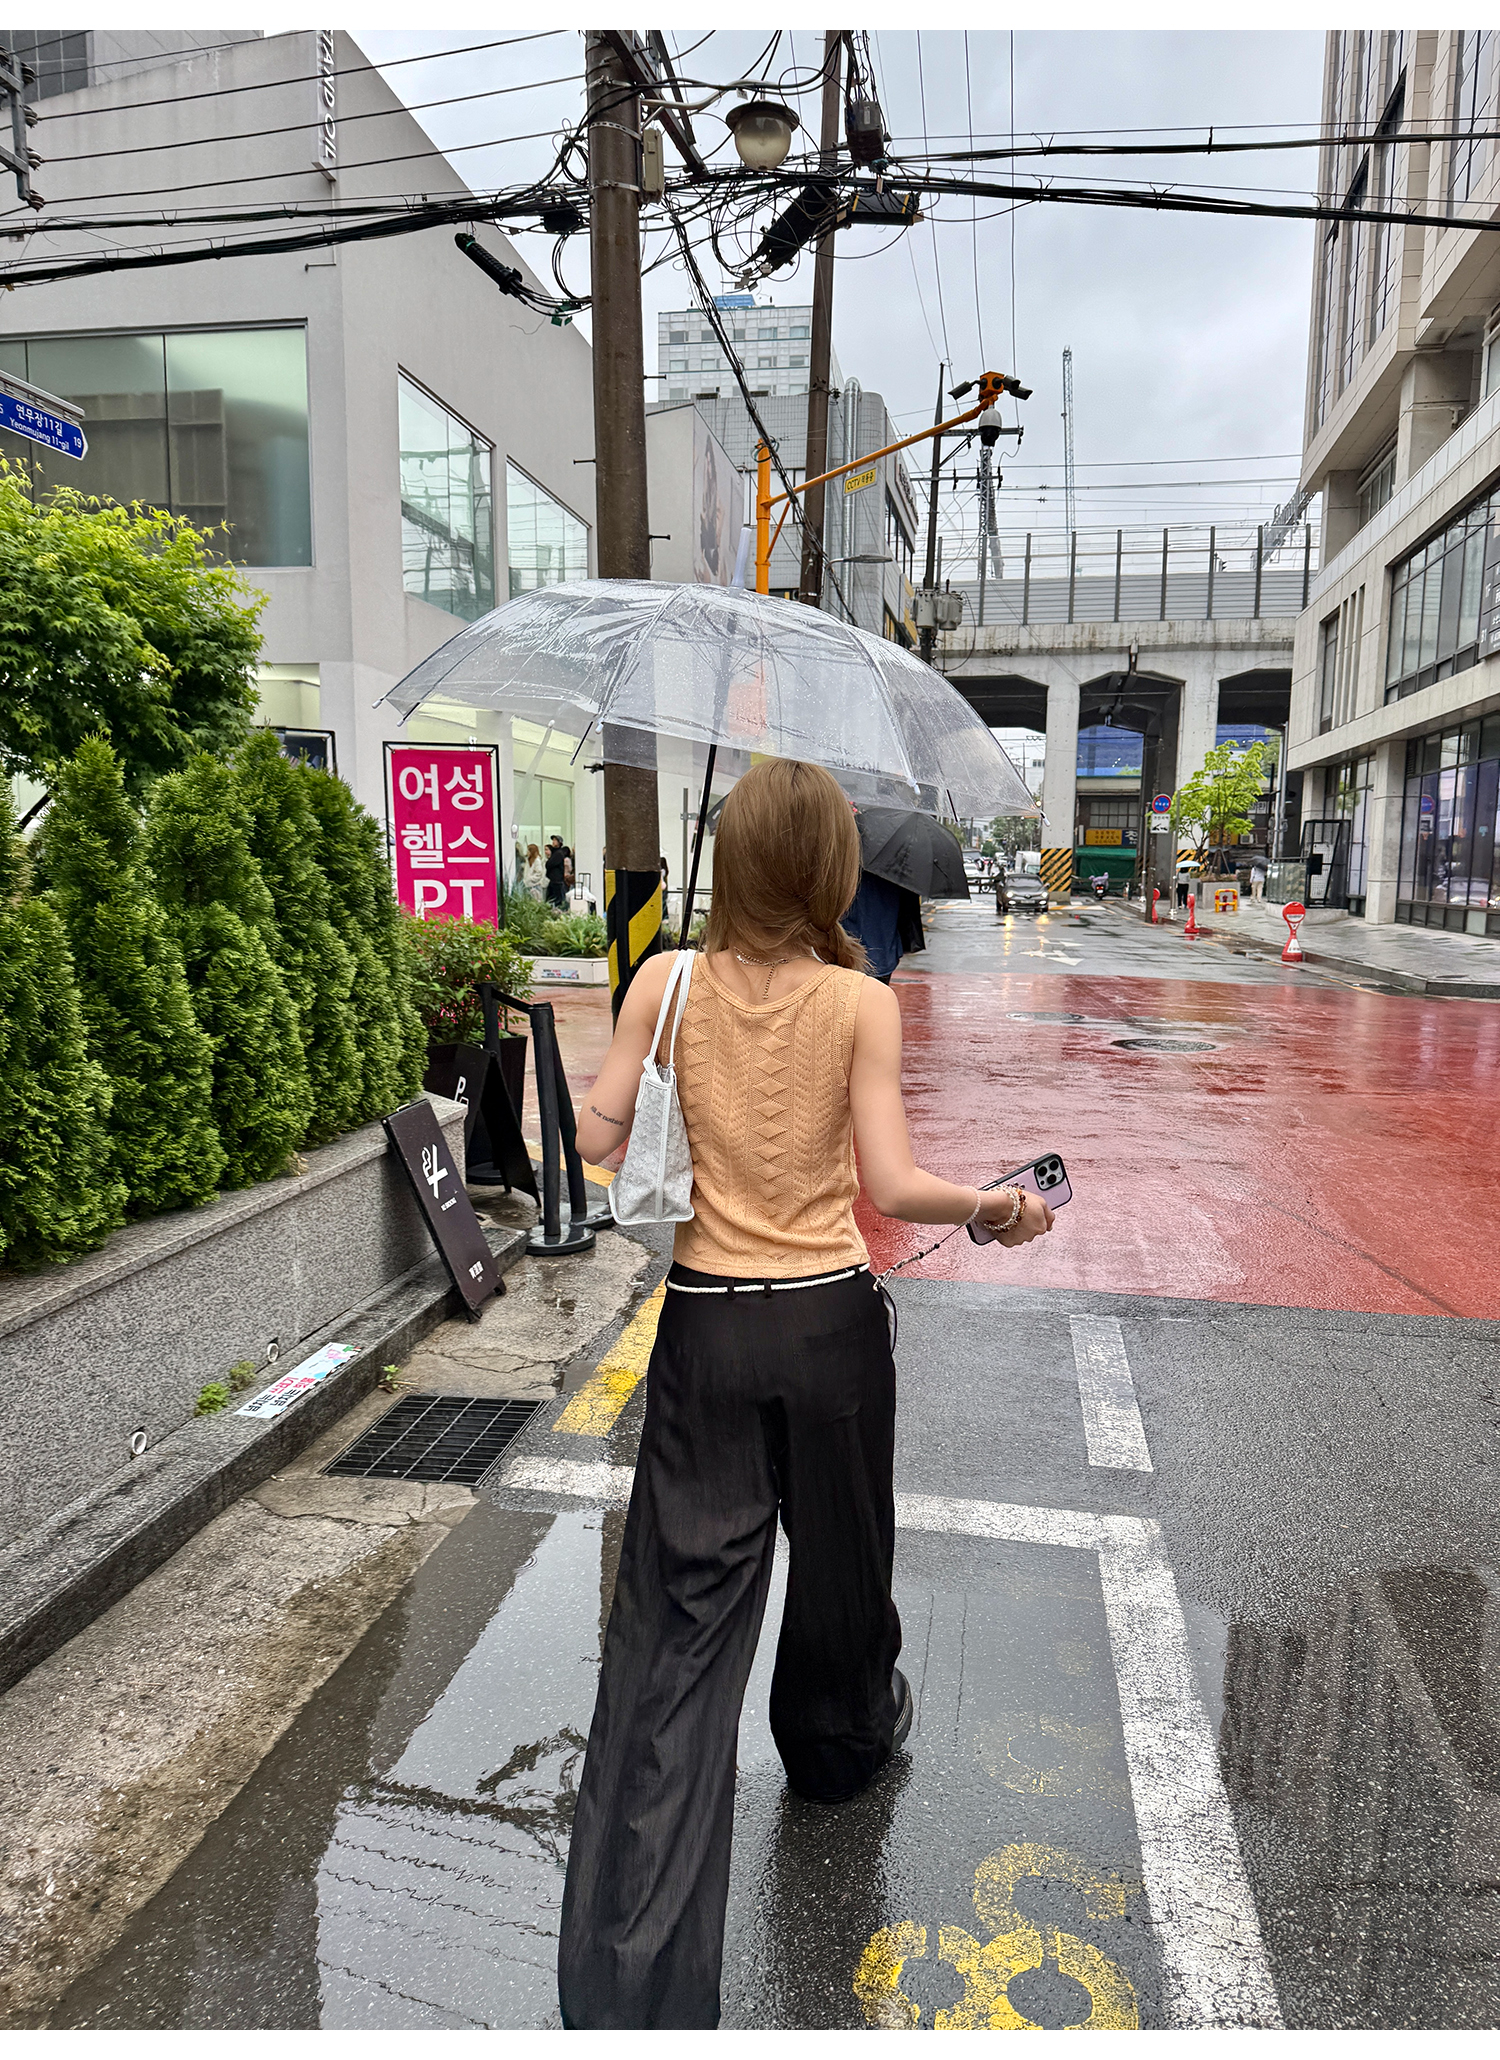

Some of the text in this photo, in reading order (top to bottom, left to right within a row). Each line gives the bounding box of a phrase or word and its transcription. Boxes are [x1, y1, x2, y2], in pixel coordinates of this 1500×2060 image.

[325, 113, 336, 159] OIL
[9, 417, 70, 451] Yeonmujang 11-gil
[15, 404, 63, 437] 연무장11길
[73, 436, 82, 449] 19
[399, 764, 484, 812] 여성
[401, 822, 490, 869] 헬스
[413, 879, 485, 923] PT
